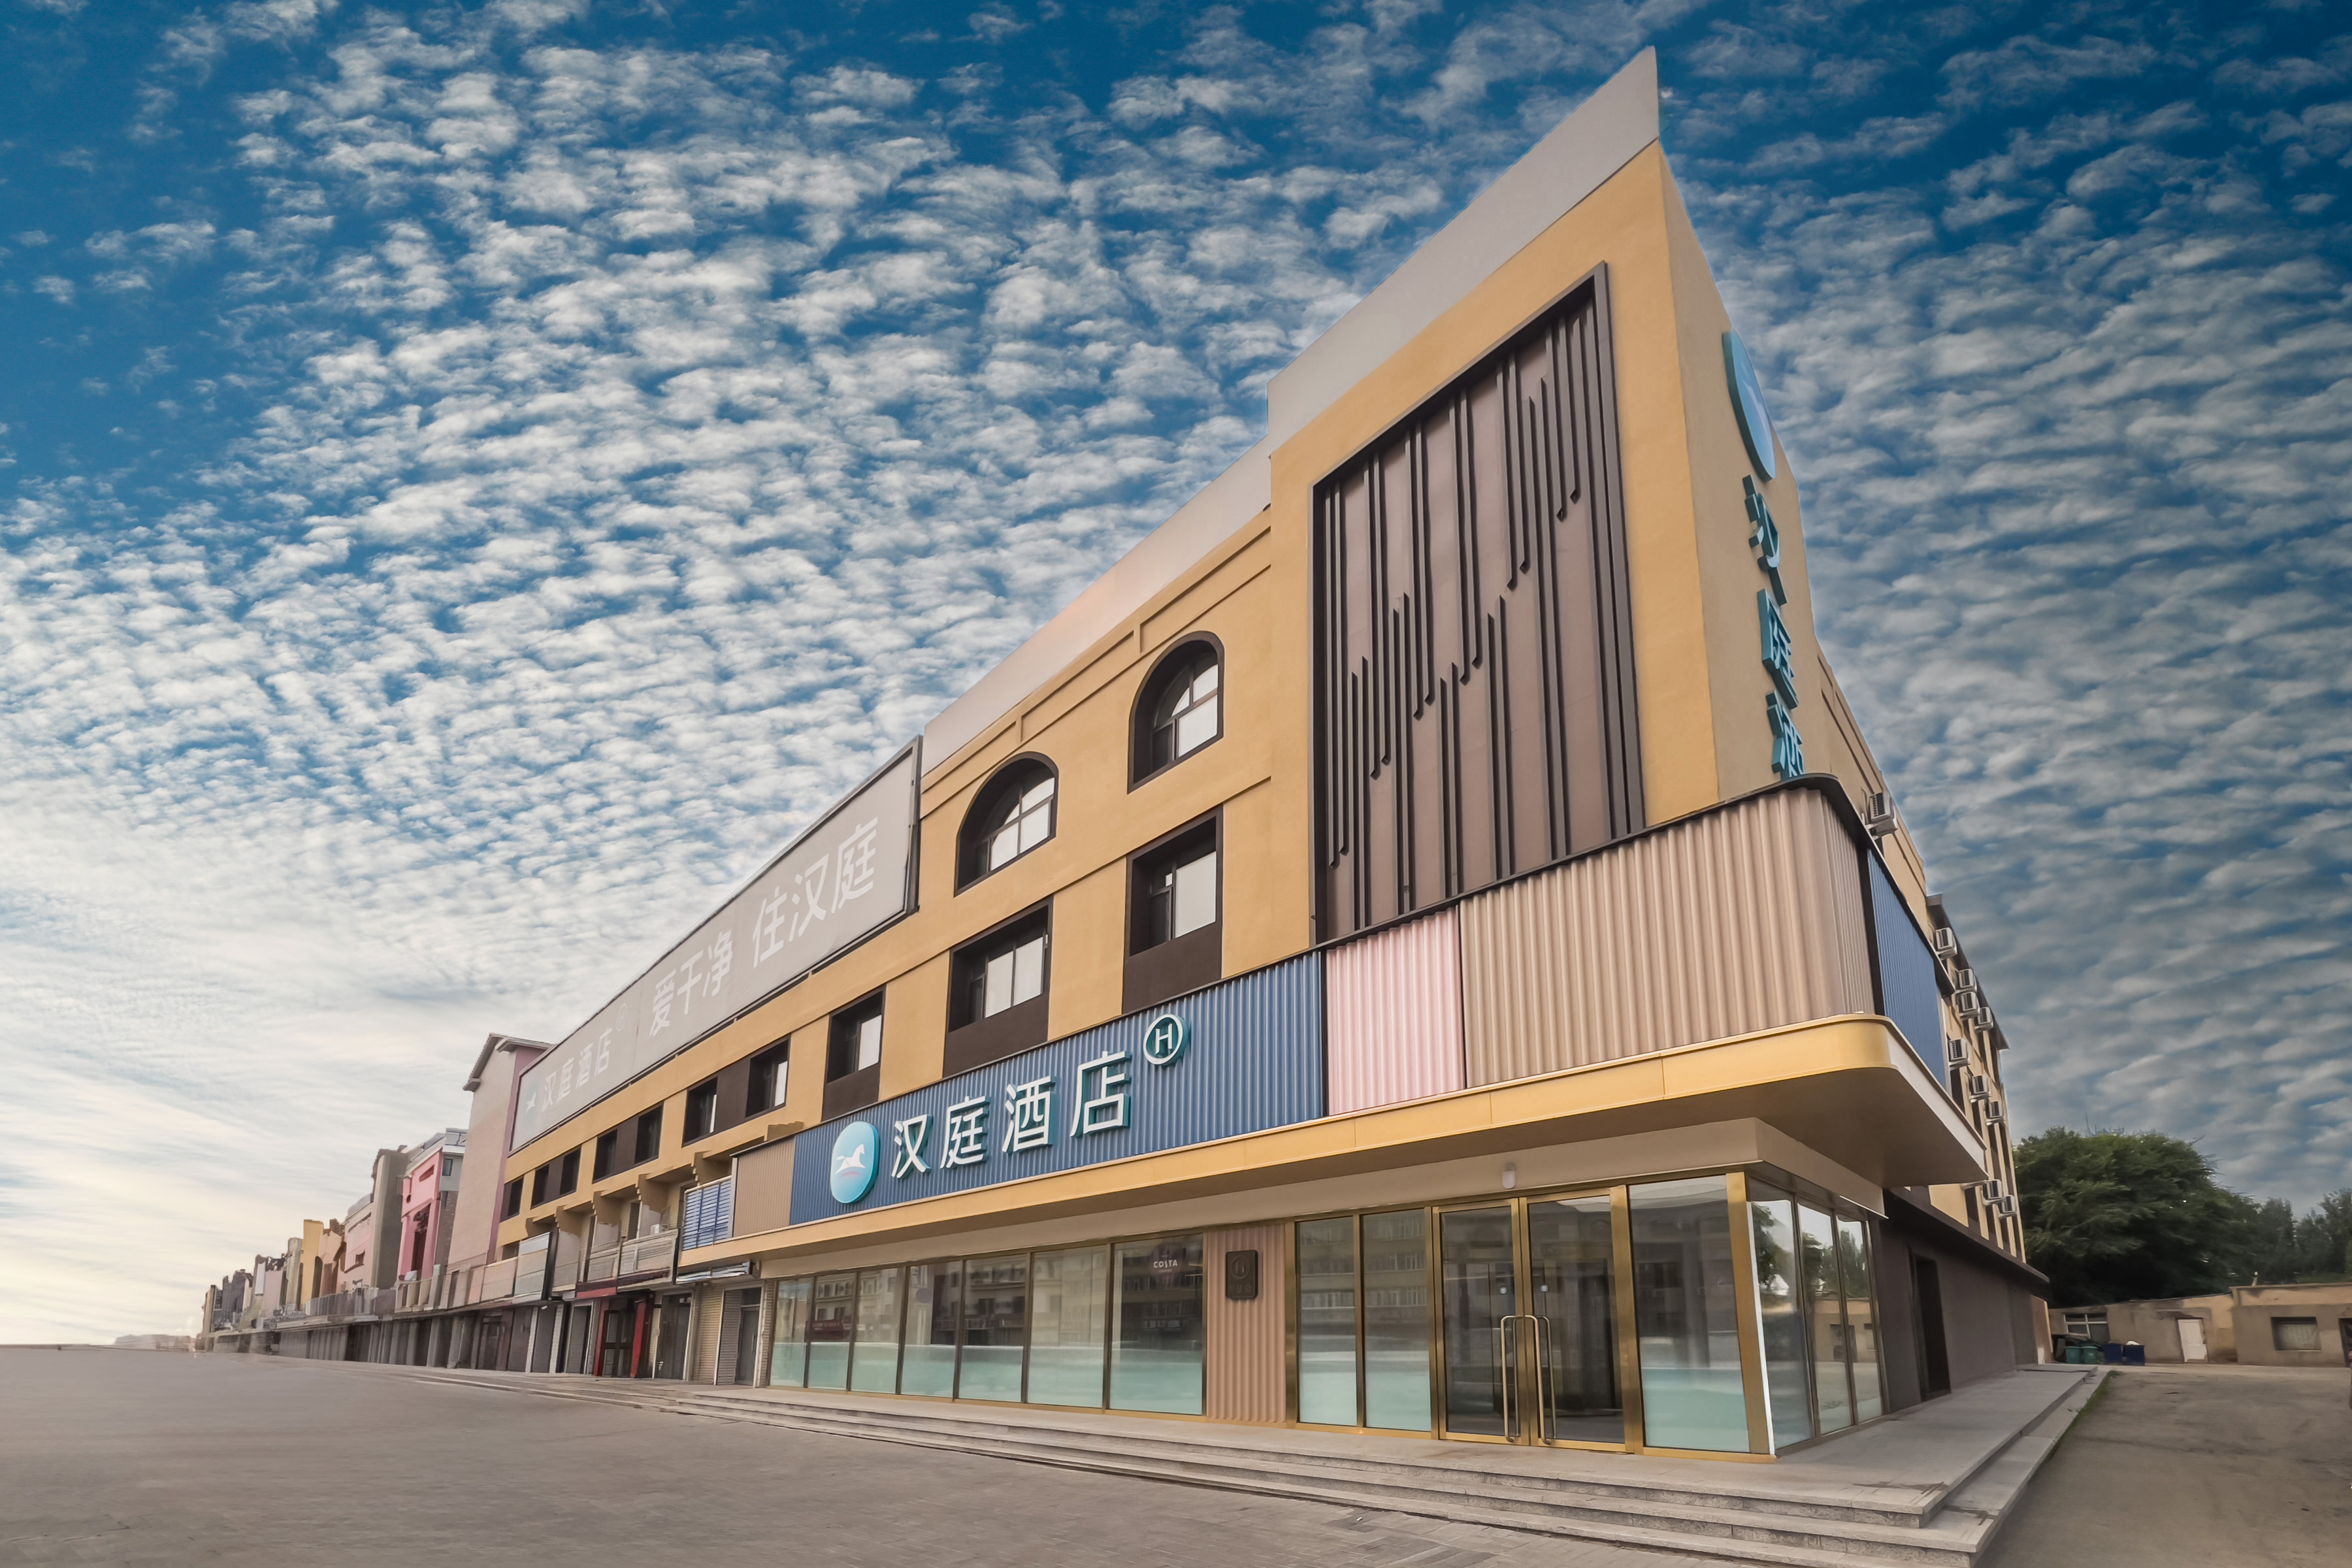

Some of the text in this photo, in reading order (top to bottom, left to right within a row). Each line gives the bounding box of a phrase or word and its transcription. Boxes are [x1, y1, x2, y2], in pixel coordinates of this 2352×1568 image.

[649, 816, 879, 1037] 爱干净 住汉庭
[542, 1027, 613, 1112] 汉庭酒店
[891, 1051, 1131, 1179] 汉庭酒店
[1153, 1259, 1178, 1268] COSTA
